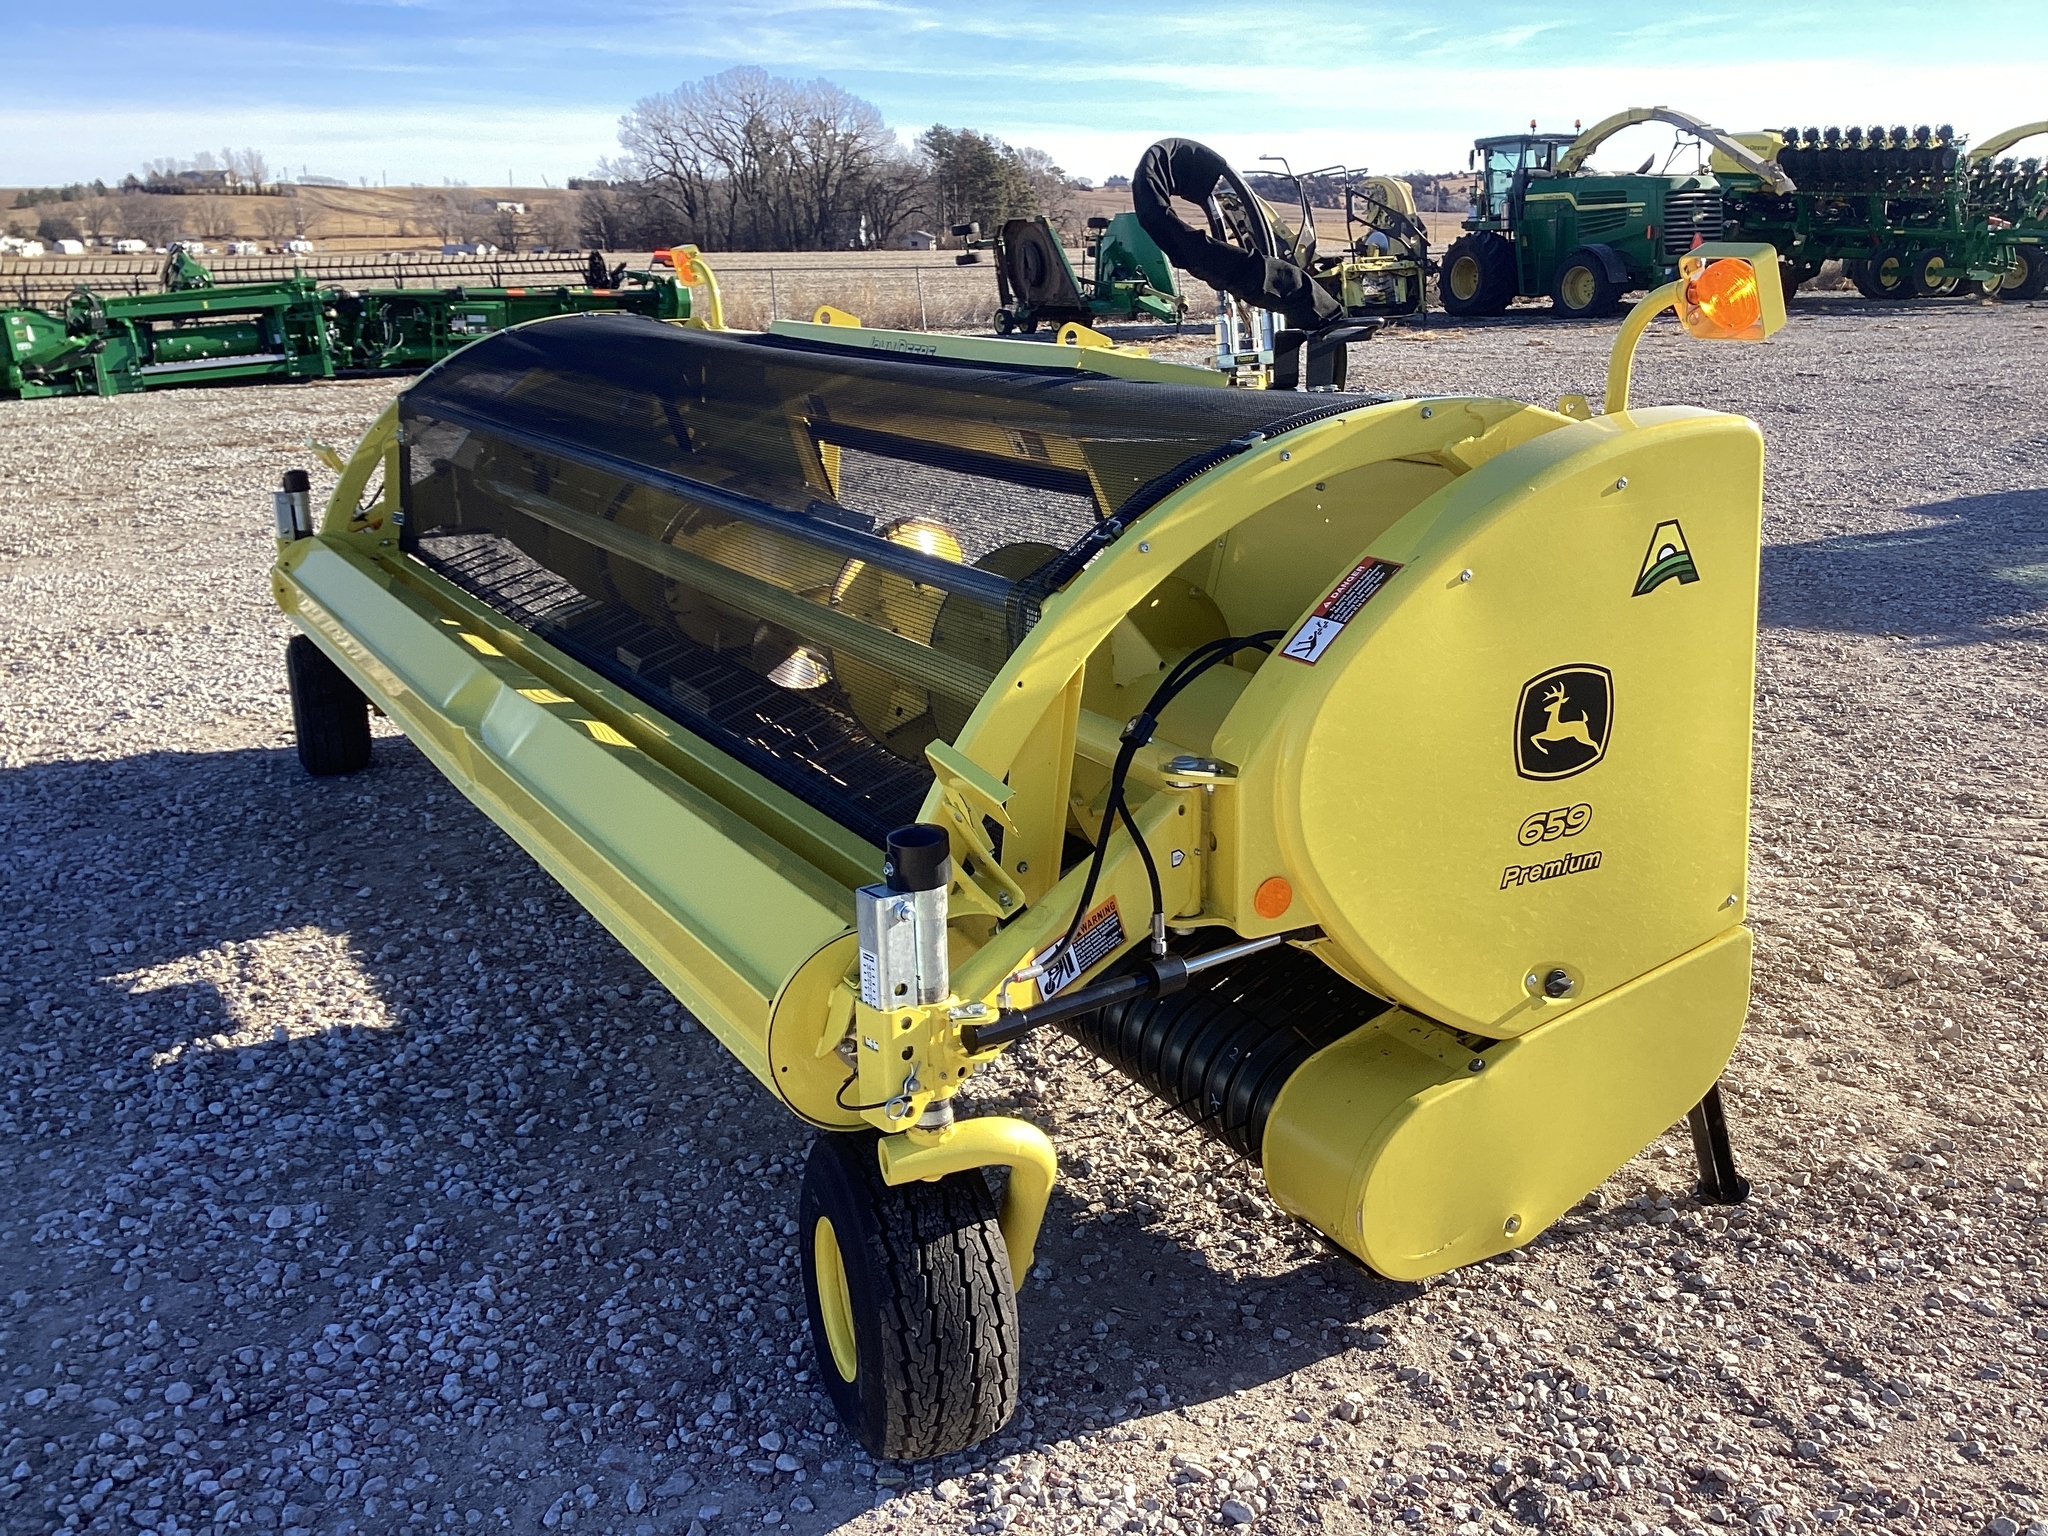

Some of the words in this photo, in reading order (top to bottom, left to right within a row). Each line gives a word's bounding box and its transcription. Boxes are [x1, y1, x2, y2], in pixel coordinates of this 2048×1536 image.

[1330, 566, 1365, 599] DANGER
[1517, 802, 1593, 847] 659
[1499, 850, 1602, 890] Premium
[1081, 901, 1116, 933] WARNING
